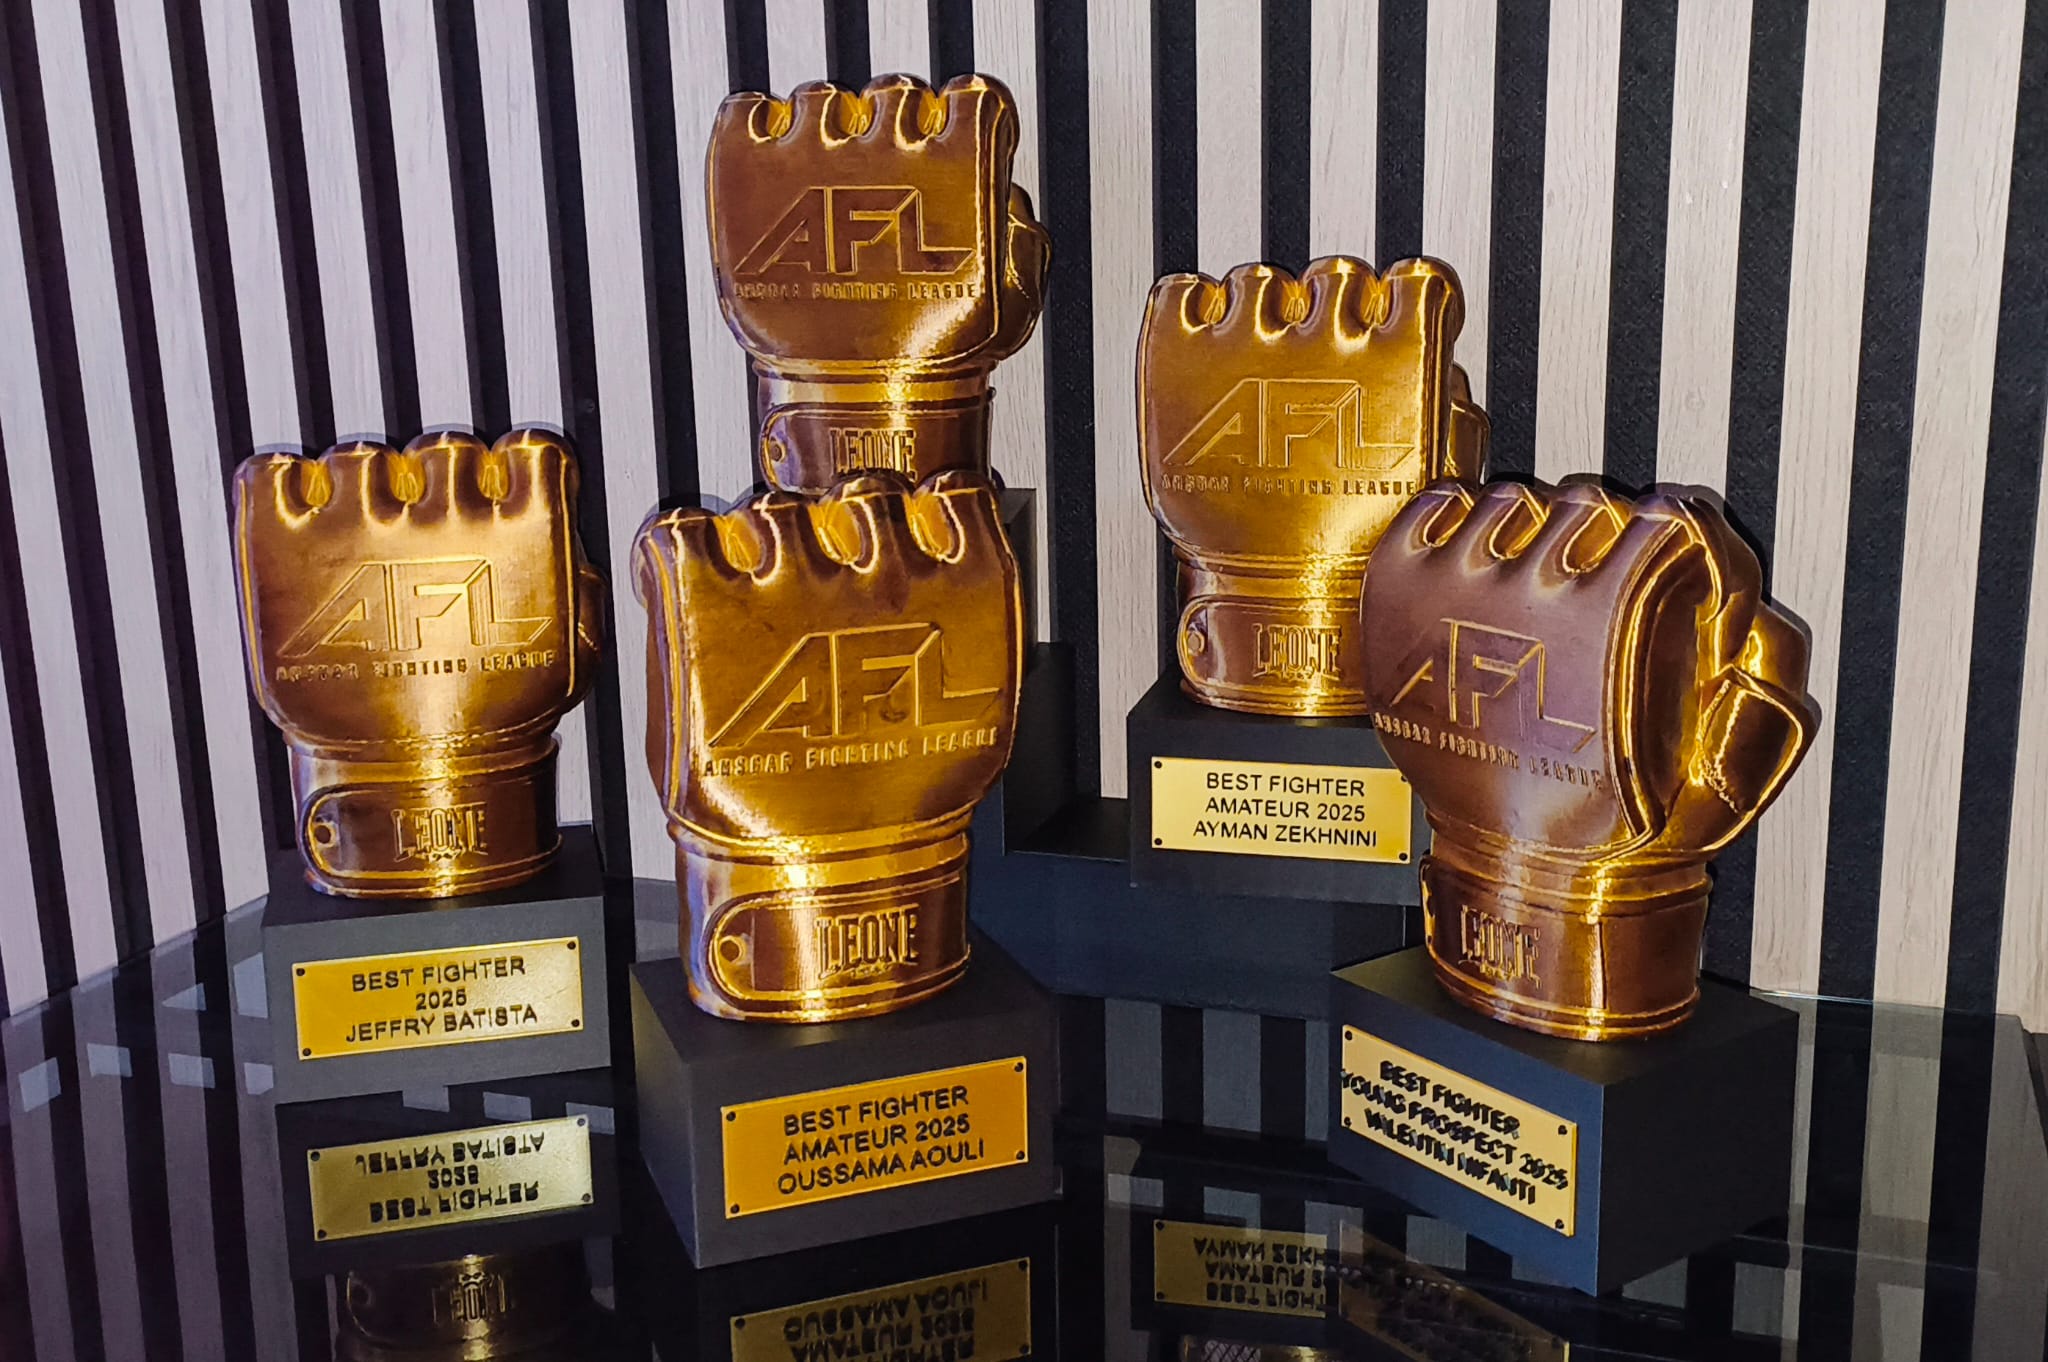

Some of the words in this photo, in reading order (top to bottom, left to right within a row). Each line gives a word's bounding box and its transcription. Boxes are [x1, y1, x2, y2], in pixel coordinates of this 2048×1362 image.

[733, 186, 978, 275] AFL
[907, 281, 978, 300] LEAGUE
[1163, 377, 1416, 470] AFL
[829, 427, 918, 482] LEONE
[1342, 479, 1416, 496] LEAGUE
[277, 555, 553, 660] AFL
[480, 649, 555, 673] LEAGUE
[1251, 623, 1342, 681] LEONE
[708, 622, 1001, 748] AFL
[1205, 797, 1309, 819] AMATEUR
[1317, 803, 1366, 822] 2025
[1206, 772, 1262, 792] BEST
[1269, 775, 1365, 798] FIGHTER
[390, 801, 489, 863] LEONE
[1193, 820, 1268, 841] AYMAN
[1274, 824, 1378, 848] ZEKHNINI
[814, 903, 920, 979] LEONE
[351, 968, 415, 993] BEST
[422, 955, 526, 986] FIGHTER
[415, 988, 468, 1011] 2025
[345, 1014, 436, 1043] JEFFRY
[443, 1003, 539, 1032] BATISTA
[783, 1104, 852, 1137] BEST
[859, 1085, 969, 1123] FIGHTER
[1380, 1060, 1431, 1097] BEST
[1432, 1084, 1521, 1140] FIGHTER
[783, 1126, 908, 1166] AMATEUR
[915, 1113, 970, 1143] 2025
[1340, 1068, 1407, 1114] YOUNG
[1408, 1101, 1518, 1165] PROSPECT
[1518, 1152, 1569, 1190] 2025
[1363, 1107, 1454, 1167] VALENTIN
[777, 1154, 907, 1195] OUSSAMA
[910, 1138, 984, 1168] AOULI
